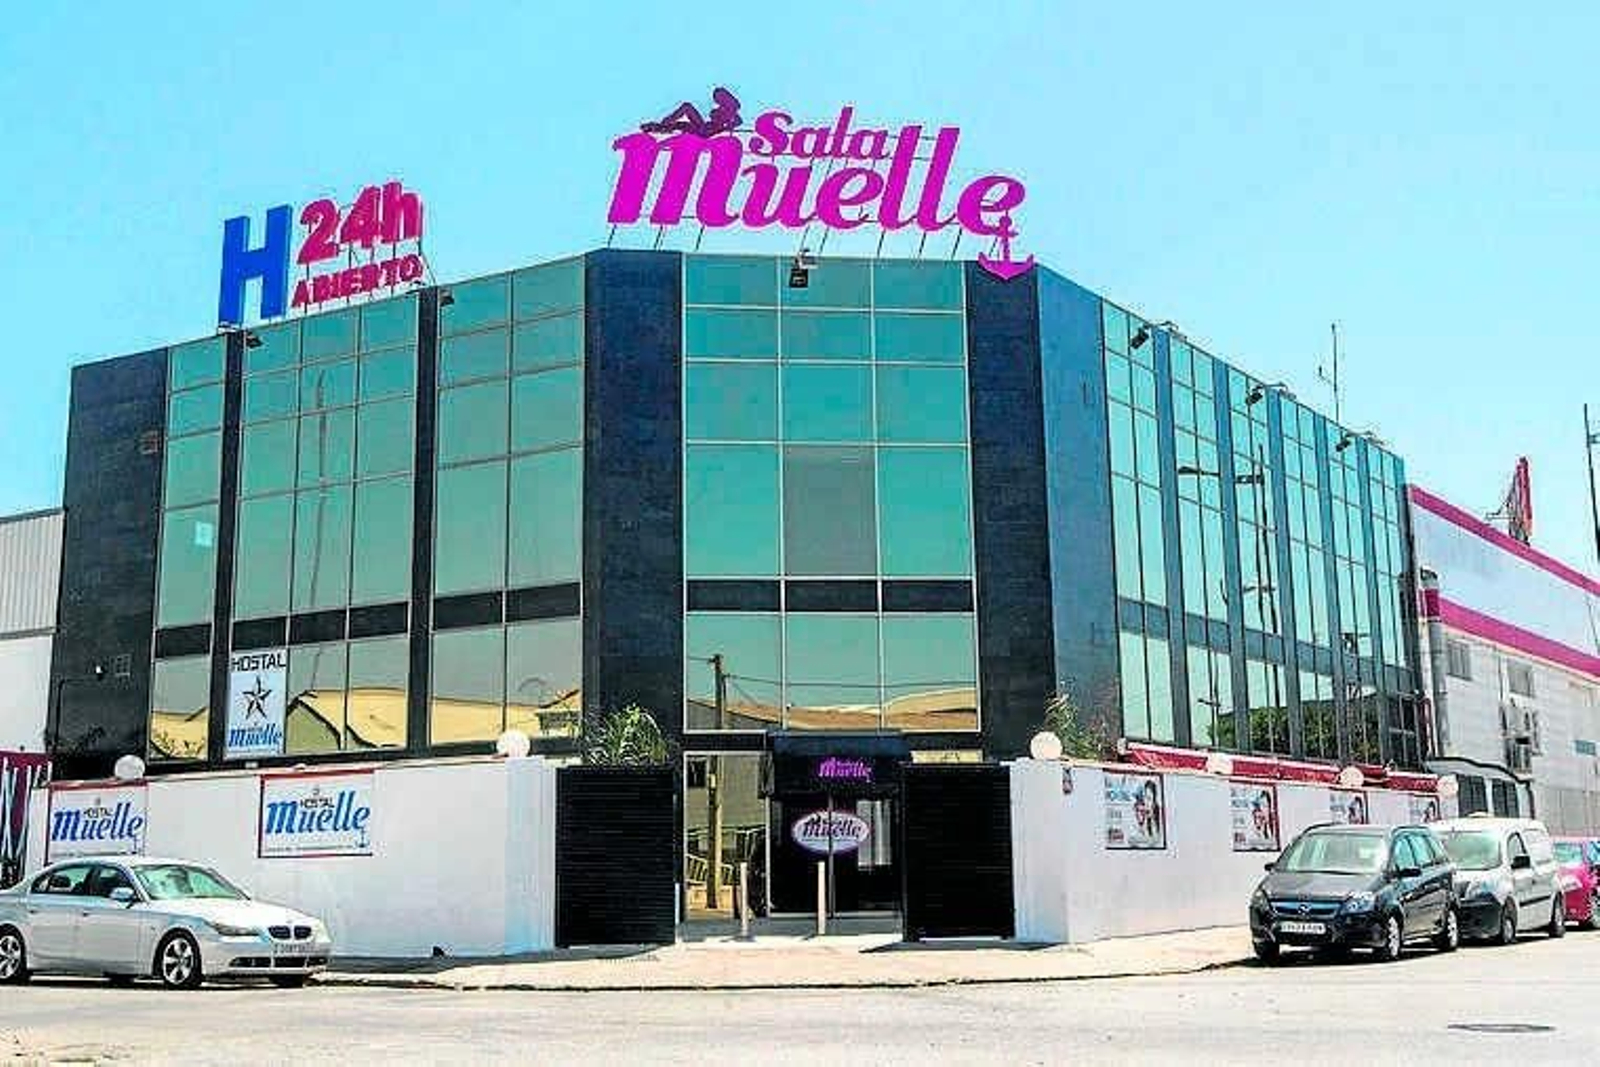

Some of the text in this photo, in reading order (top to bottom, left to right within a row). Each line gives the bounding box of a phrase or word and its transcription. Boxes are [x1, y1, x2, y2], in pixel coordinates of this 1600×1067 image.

[749, 106, 888, 160] Sala
[297, 181, 423, 265] 24h
[219, 204, 292, 324] H
[291, 253, 423, 308] ABIERTO
[231, 653, 287, 671] HOSTAL
